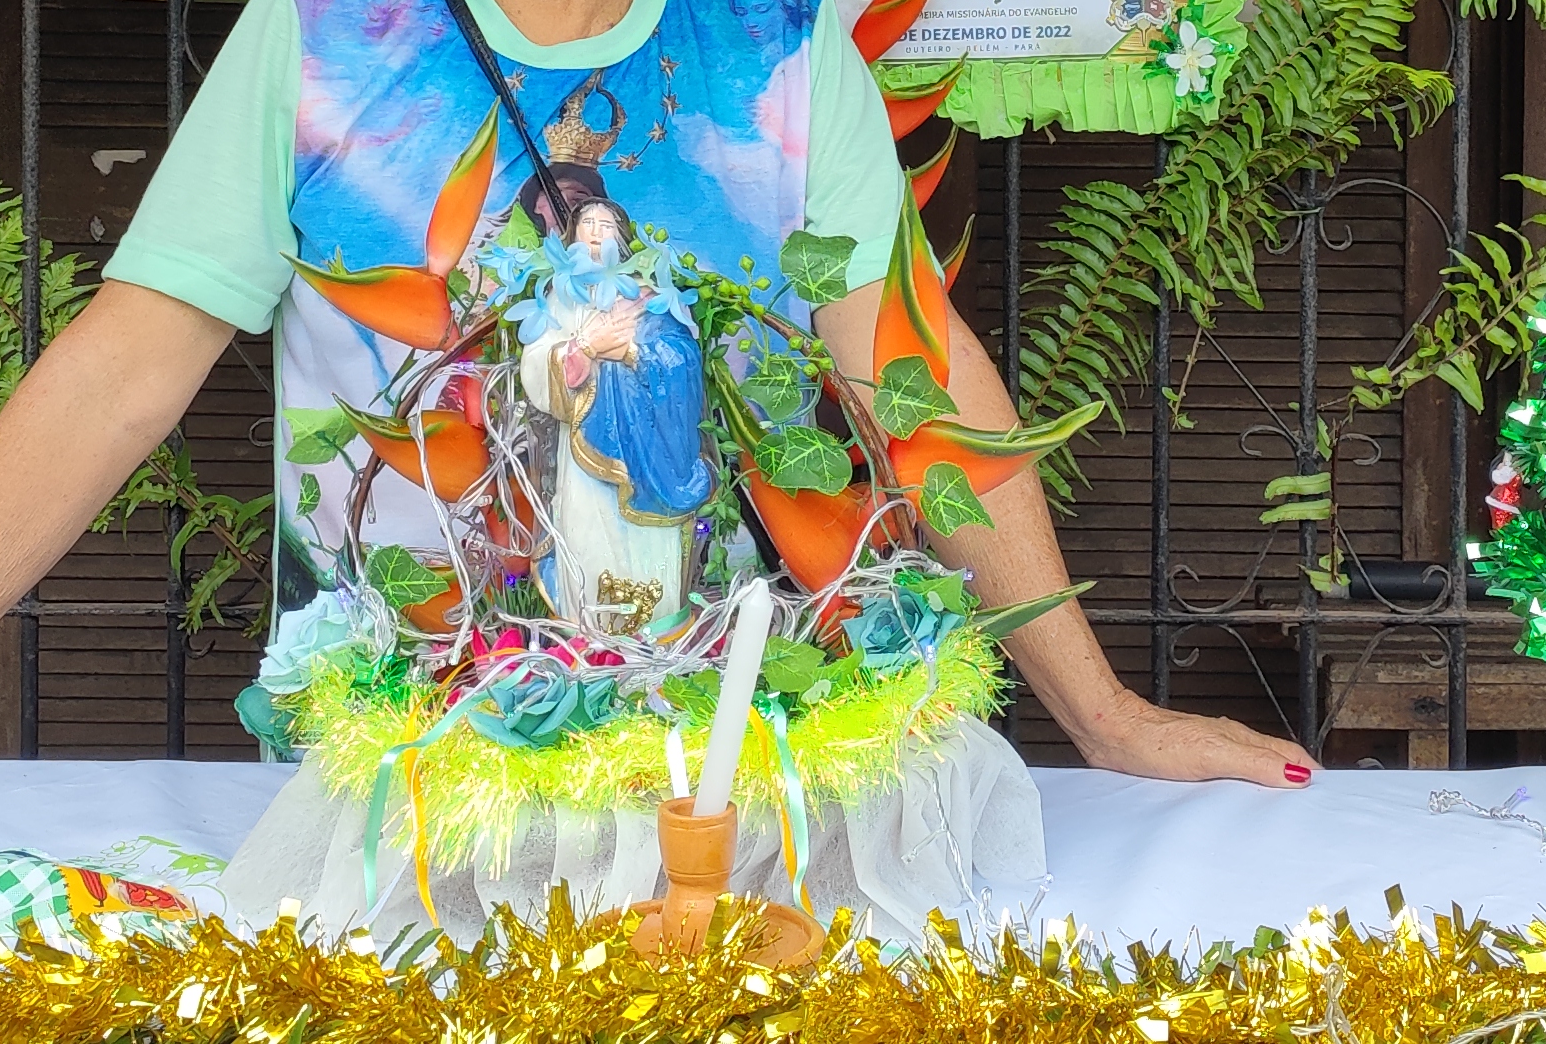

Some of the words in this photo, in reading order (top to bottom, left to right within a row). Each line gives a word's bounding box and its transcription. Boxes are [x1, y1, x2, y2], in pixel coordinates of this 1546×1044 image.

[946, 7, 1006, 19] MISSIONÁRIA
[1008, 8, 1022, 17] DO
[1023, 6, 1078, 17] EVANGELHO
[921, 26, 1007, 42] DEZEMBRO
[1011, 25, 1032, 39] DE
[1035, 25, 1072, 38] 2022
[905, 45, 952, 54] OUTEIRO
